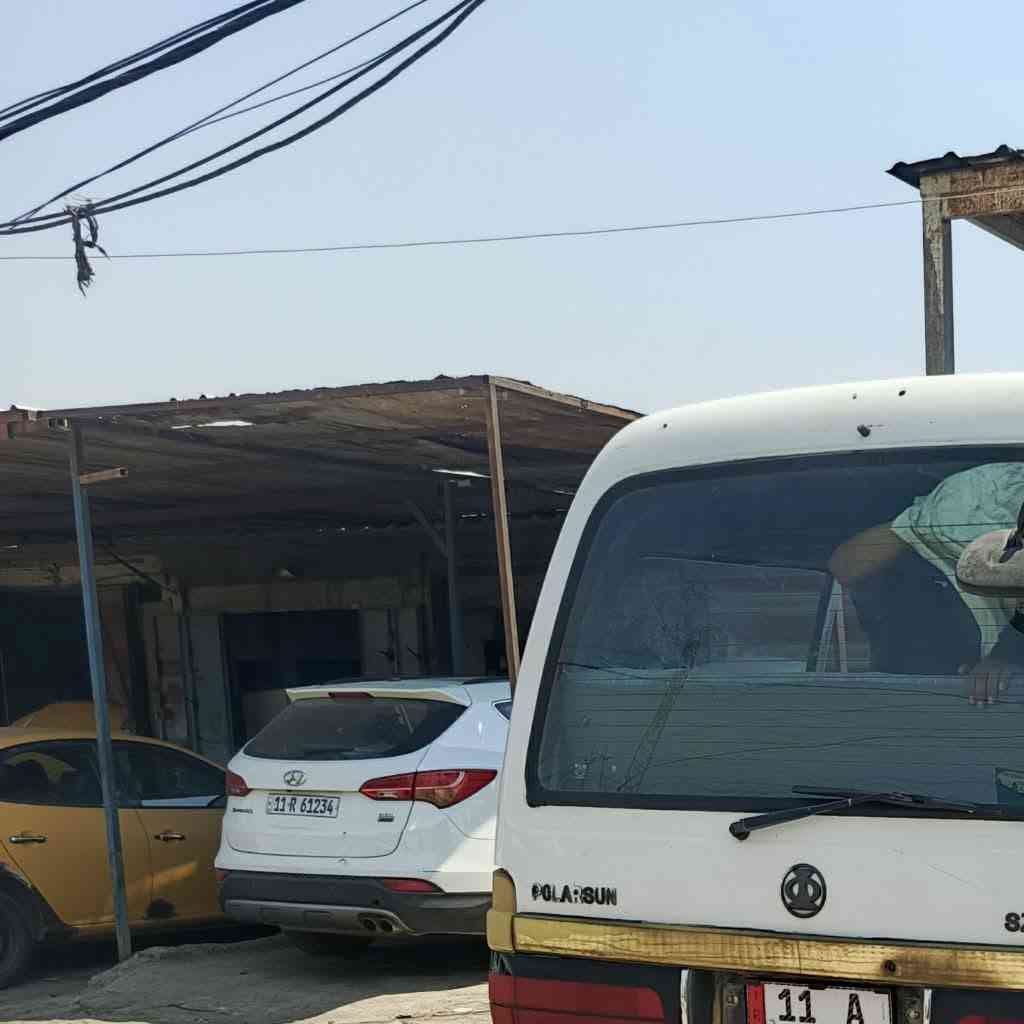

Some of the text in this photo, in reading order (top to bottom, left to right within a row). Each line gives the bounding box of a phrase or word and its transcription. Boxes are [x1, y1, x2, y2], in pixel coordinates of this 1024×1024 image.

[274, 797, 287, 812] 11
[300, 798, 334, 815] 61234
[778, 988, 816, 1024] 11
